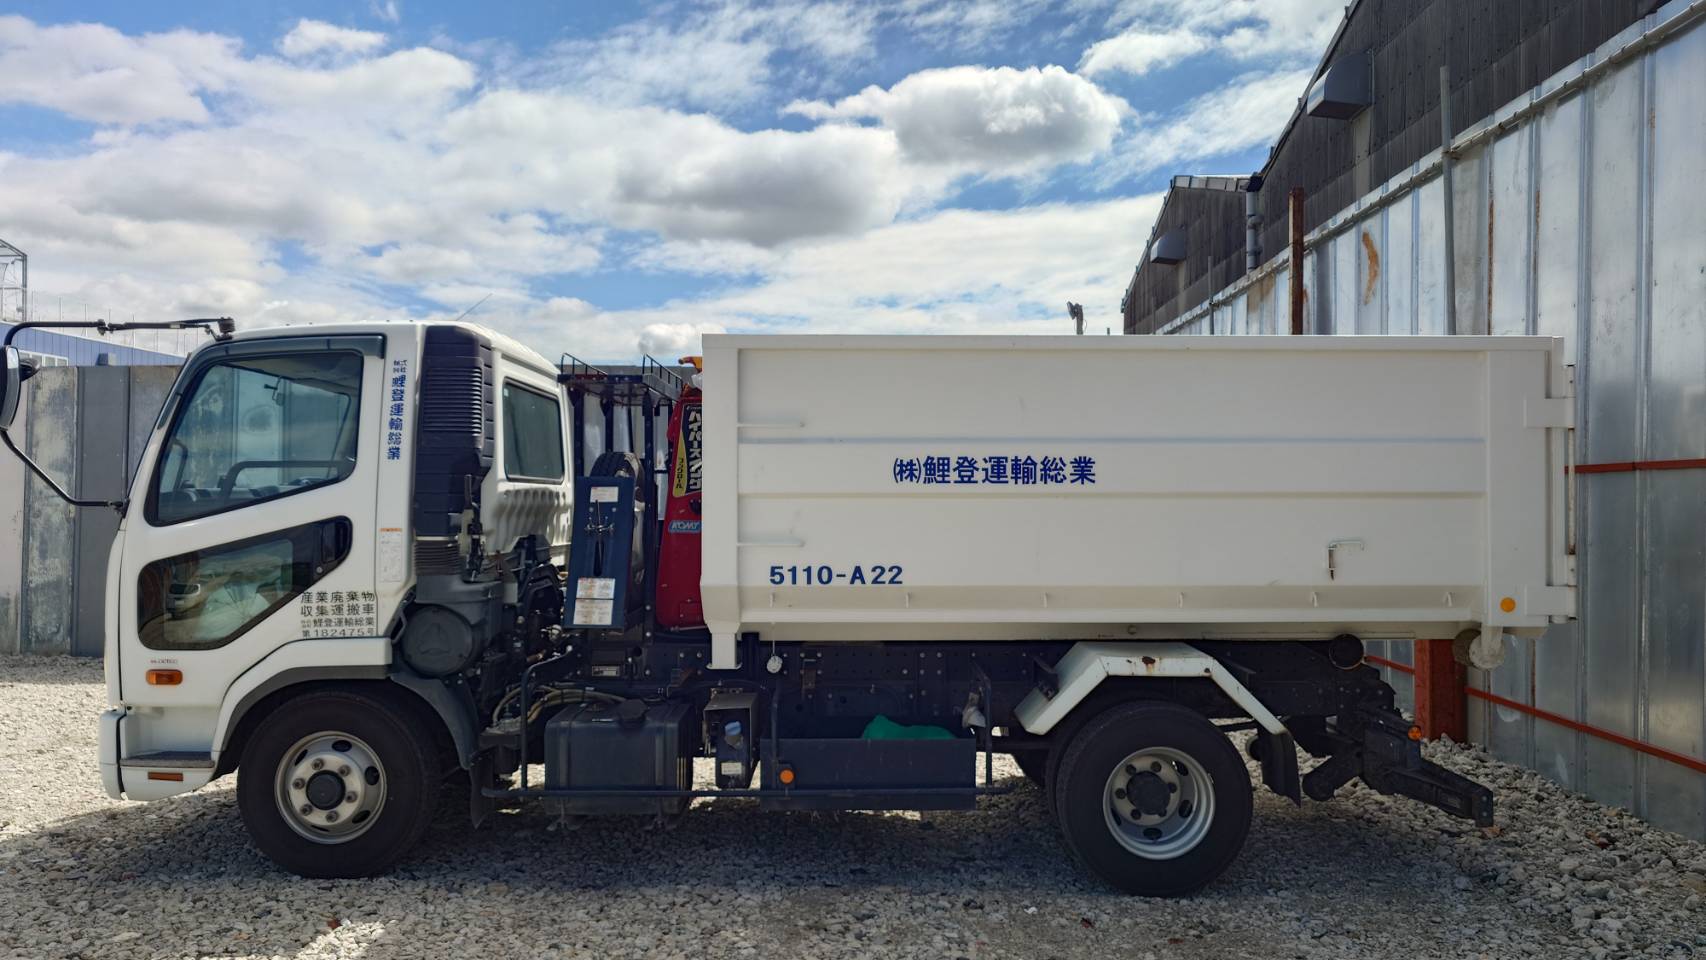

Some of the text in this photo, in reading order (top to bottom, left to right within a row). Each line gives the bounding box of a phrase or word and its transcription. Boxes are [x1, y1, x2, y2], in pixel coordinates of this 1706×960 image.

[769, 565, 903, 585] 5110-A22
[300, 591, 375, 603] 産業廃棄物
[300, 603, 375, 617] 収集運搬車
